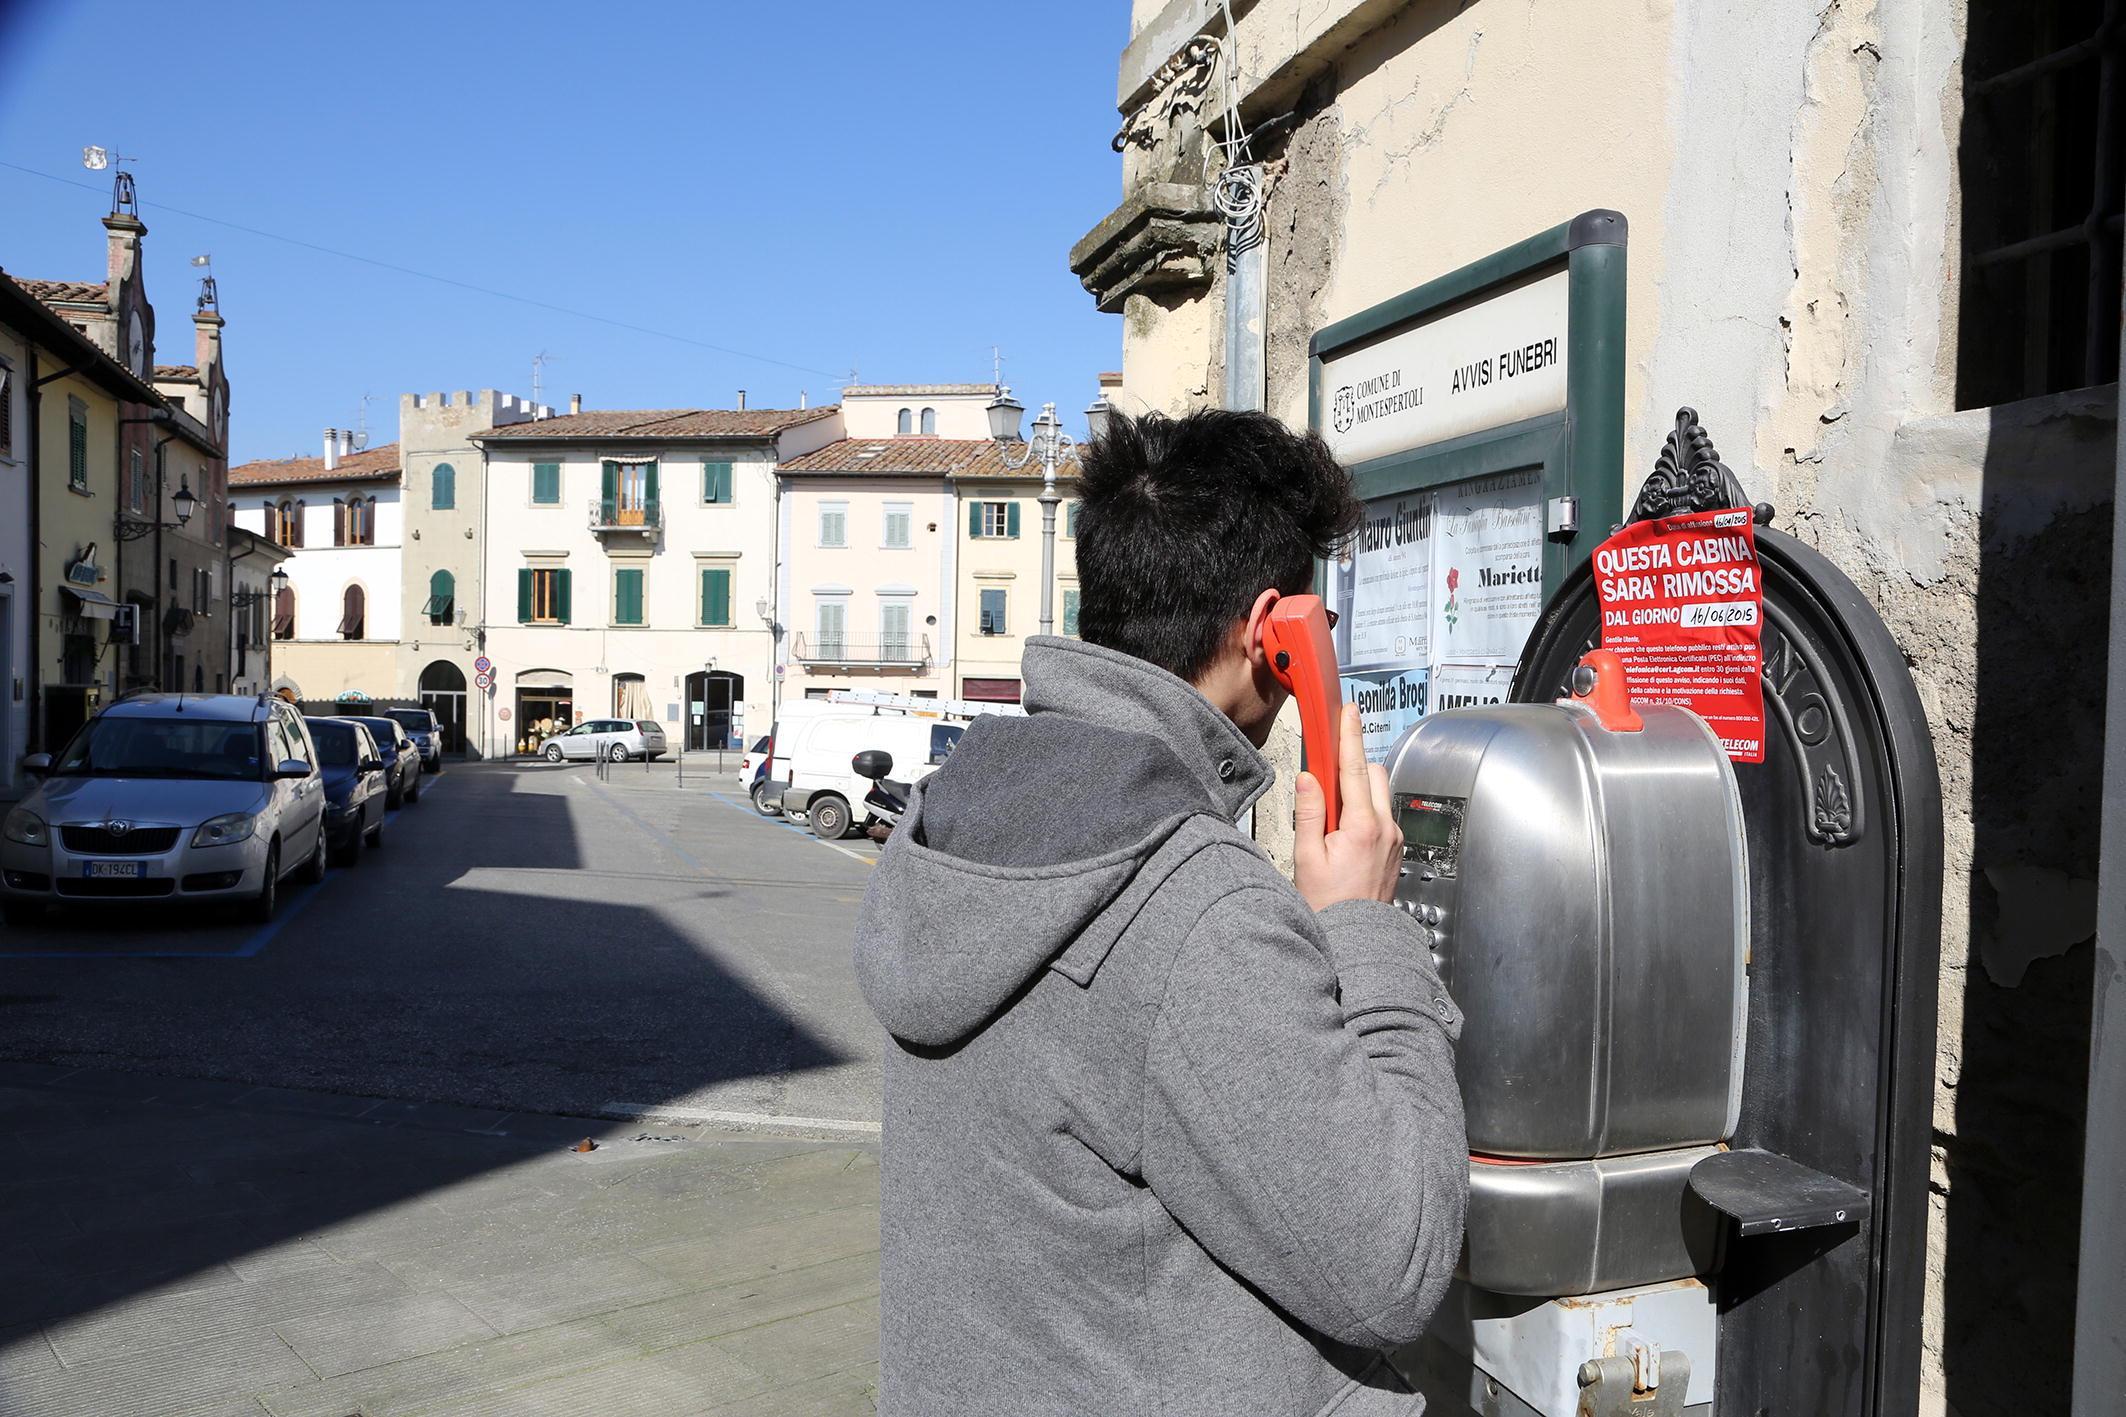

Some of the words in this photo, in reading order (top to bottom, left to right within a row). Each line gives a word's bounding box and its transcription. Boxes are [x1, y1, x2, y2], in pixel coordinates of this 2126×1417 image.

[1452, 358, 1492, 395] AVVISI
[1499, 337, 1557, 381] FUNEBRI
[1356, 373, 1389, 400] COMUNE
[1393, 369, 1401, 388] DI
[1356, 387, 1423, 425] MONTESPERTOLI
[1359, 511, 1391, 555] Mauro
[1396, 497, 1432, 547] Giuntin
[1597, 544, 1672, 577] QUESTA
[1677, 536, 1753, 566] CABINA
[1478, 564, 1542, 587] Mariett
[1601, 575, 1657, 602] SARA'
[1663, 567, 1756, 598] RIMOSSA
[1605, 611, 1629, 626] DAL
[1632, 607, 1680, 624] GIORNO
[1690, 605, 1753, 626] 16/06/2015
[1688, 644, 1711, 652] pubblico
[1400, 673, 1428, 716] Brogi
[1720, 739, 1758, 750] TELECOM
